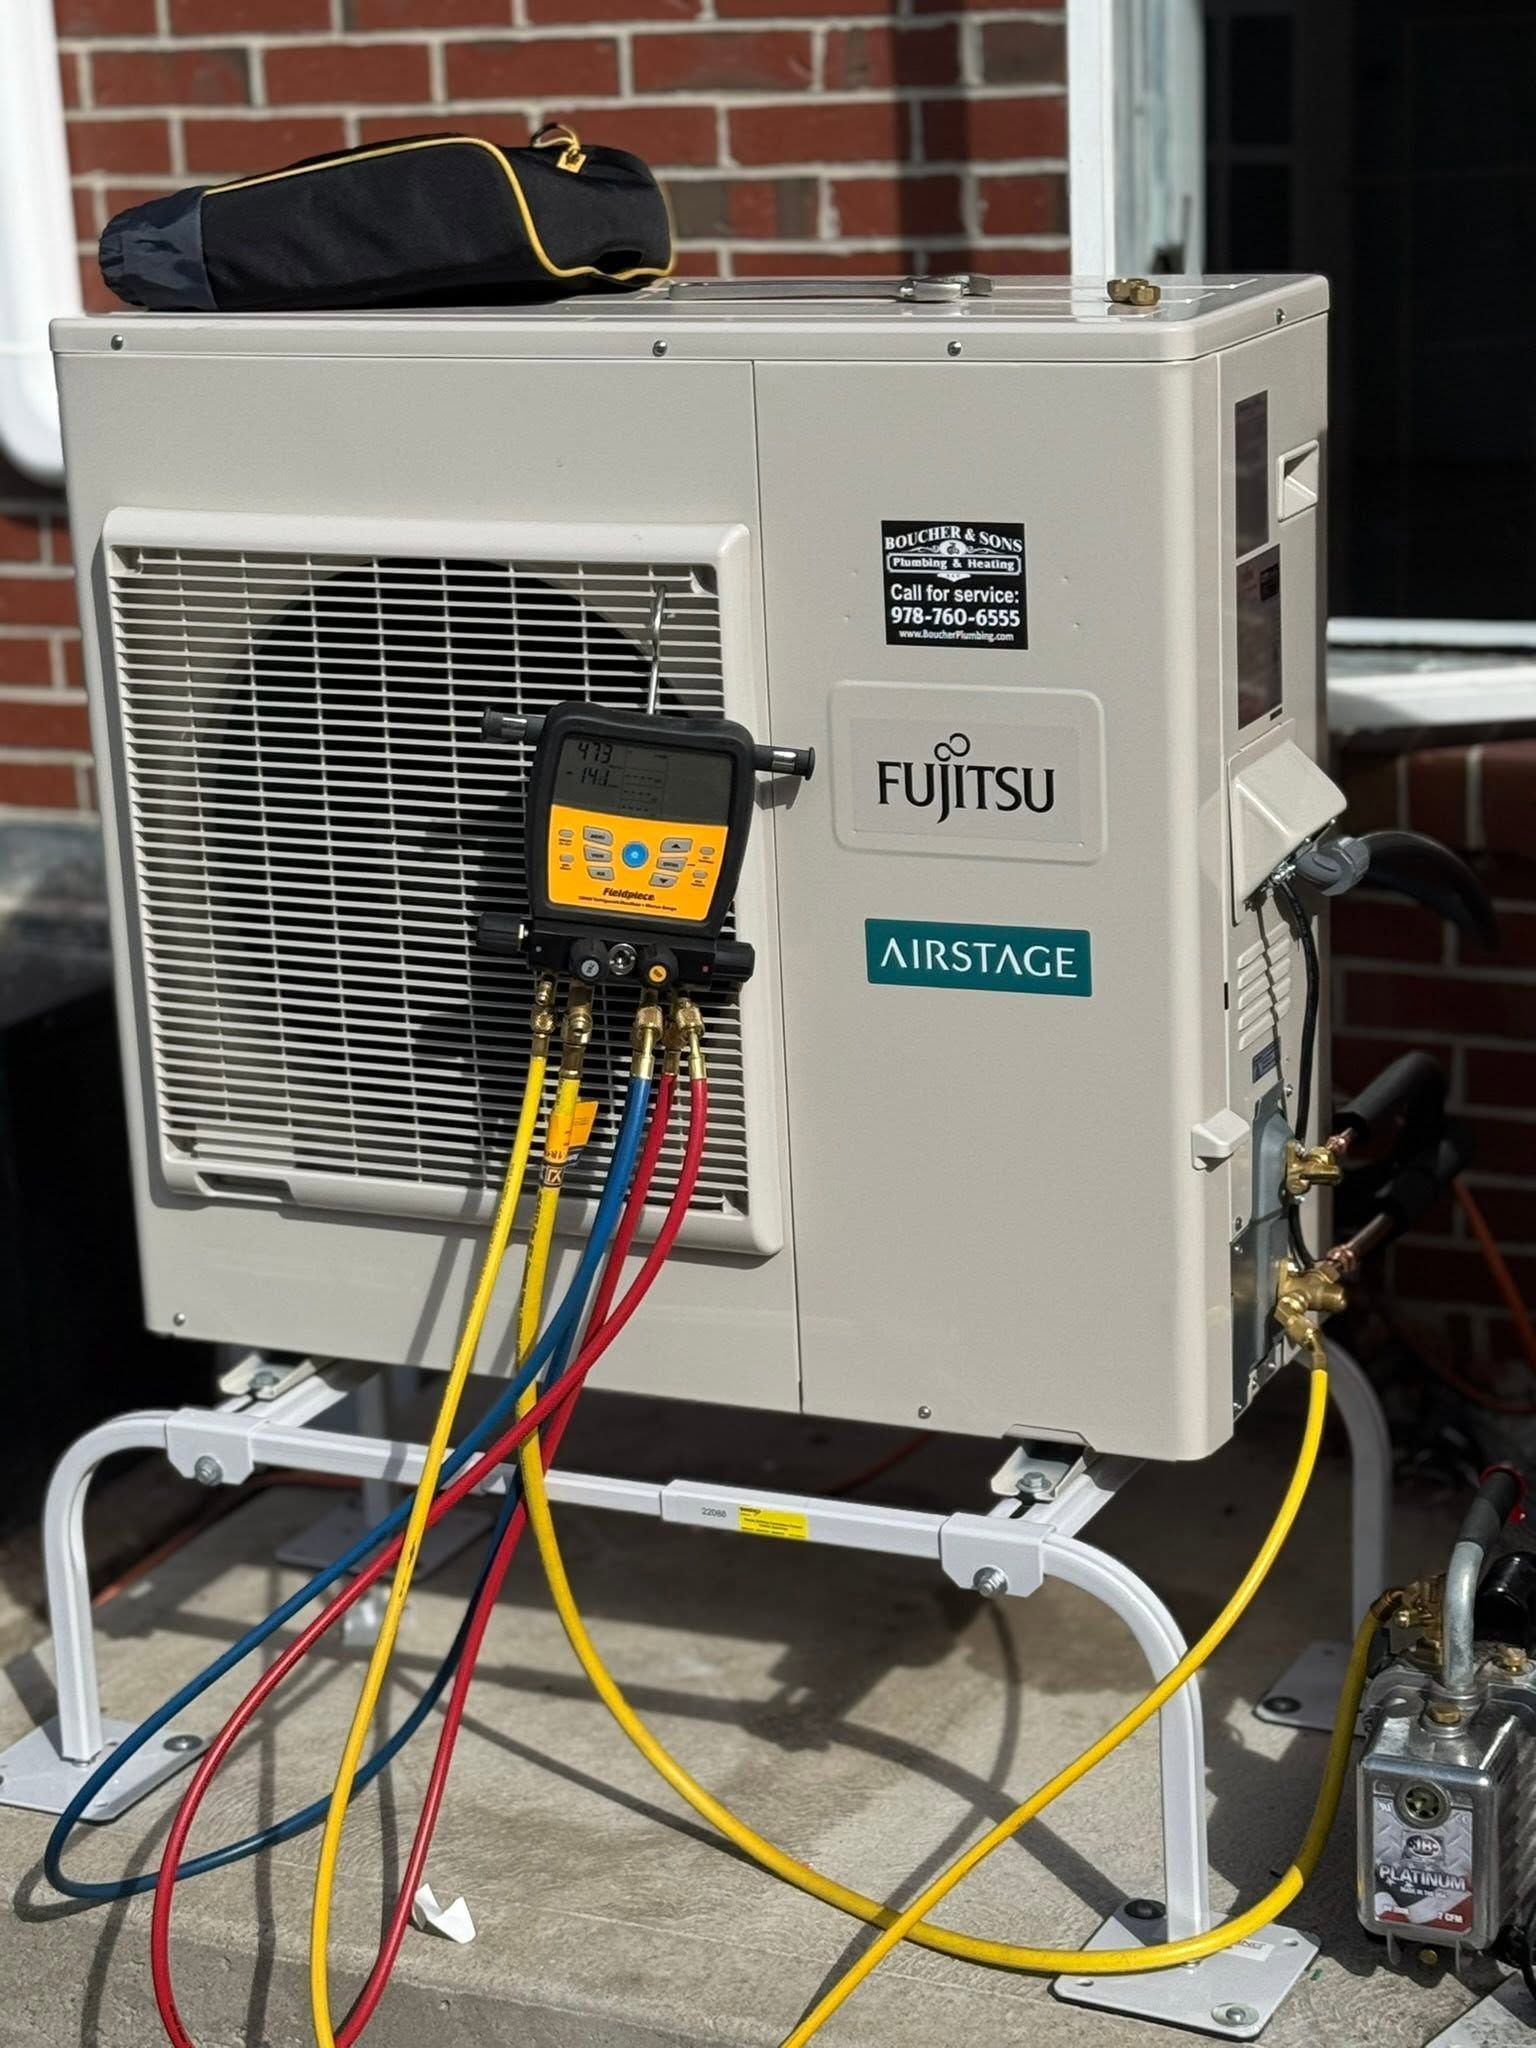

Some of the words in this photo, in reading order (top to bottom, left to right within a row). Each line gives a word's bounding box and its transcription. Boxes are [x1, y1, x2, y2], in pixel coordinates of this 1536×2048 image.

[884, 525, 961, 550] BOUCHER
[965, 528, 976, 542] &
[979, 531, 1023, 553] SONS
[893, 557, 948, 570] Plumbing
[952, 559, 962, 568] &
[968, 559, 1015, 571] Heating
[890, 583, 922, 601] Call
[926, 584, 950, 602] for
[954, 586, 1020, 604] service:
[890, 606, 1021, 627] 978-760-6555
[899, 629, 1015, 642] www.BoucherPlumbing.com
[578, 742, 613, 764] 473
[876, 760, 1055, 824] FUJITSU
[603, 887, 655, 901] Fieldpiece
[880, 937, 1078, 979] AIRSTAGE
[1379, 1865, 1466, 1891] PLATINUM
[1444, 1912, 1464, 1924] CFM
